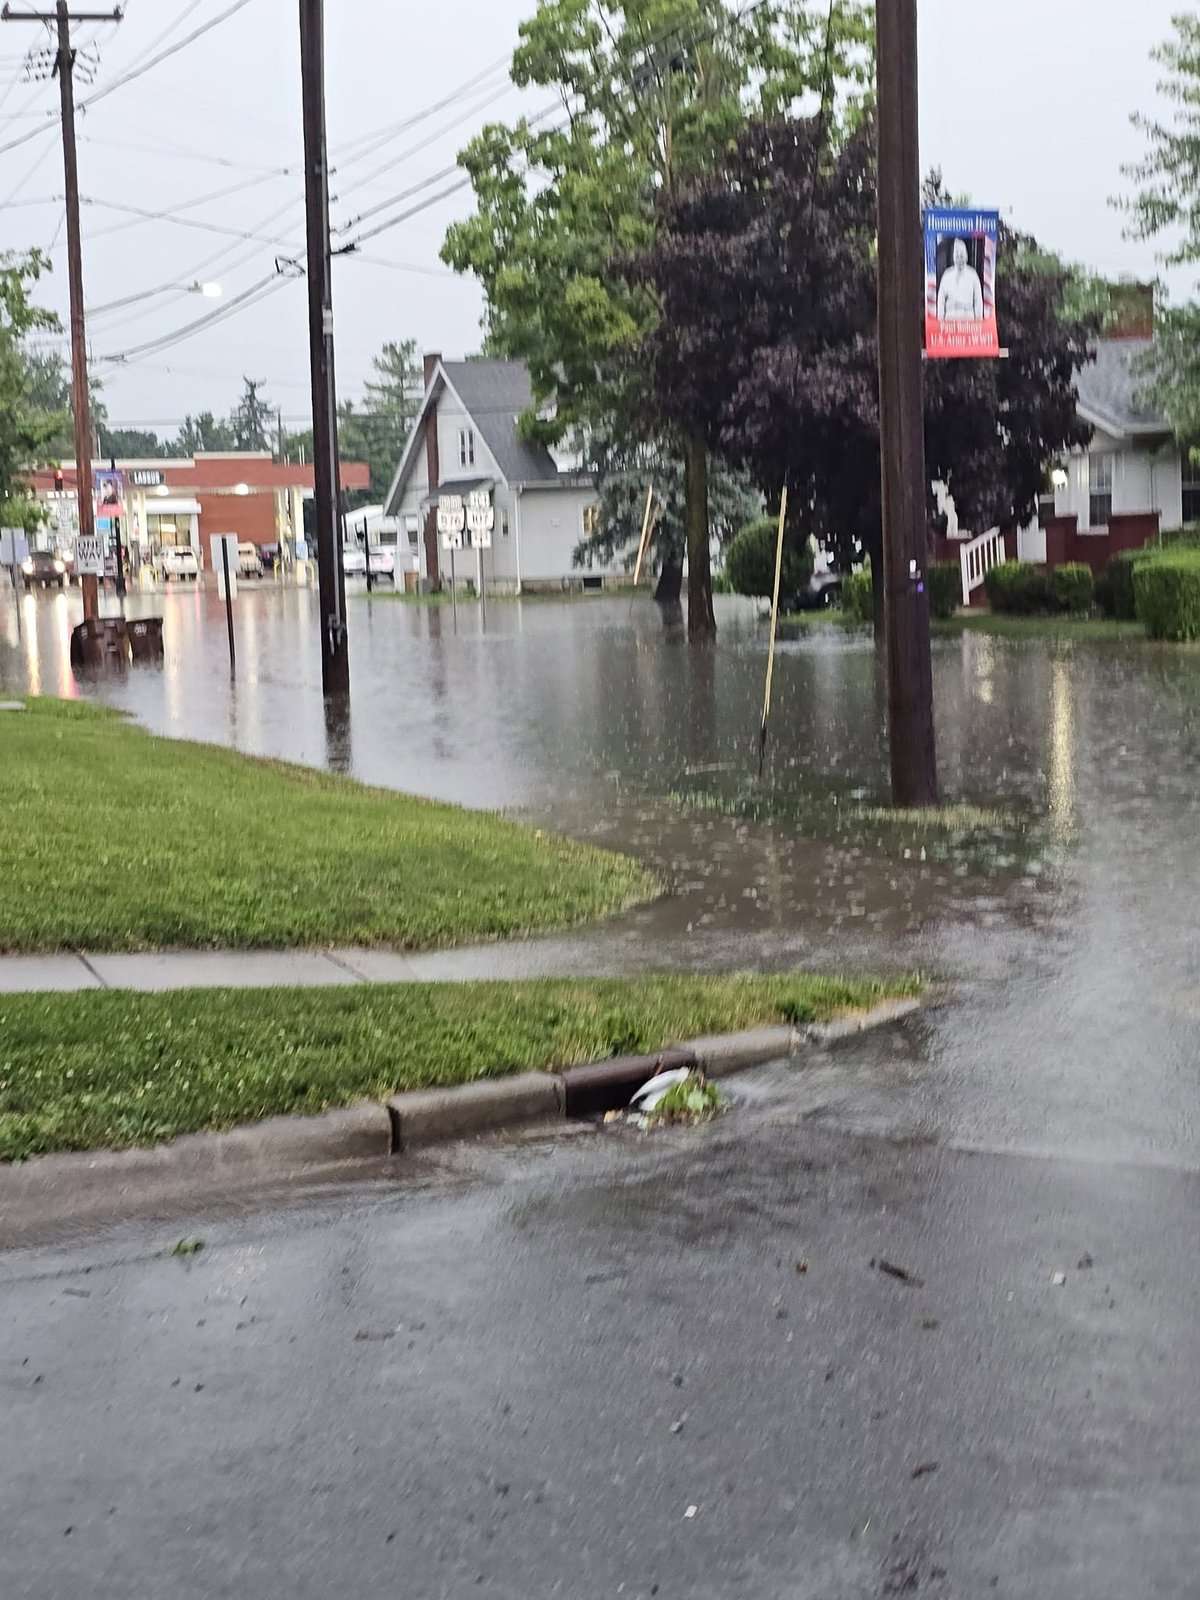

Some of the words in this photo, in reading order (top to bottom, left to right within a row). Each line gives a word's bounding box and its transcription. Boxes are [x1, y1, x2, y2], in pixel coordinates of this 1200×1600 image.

[927, 213, 973, 232] Hometown
[975, 215, 997, 233] Hero
[78, 540, 102, 550] ONE
[78, 551, 102, 561] WAY
